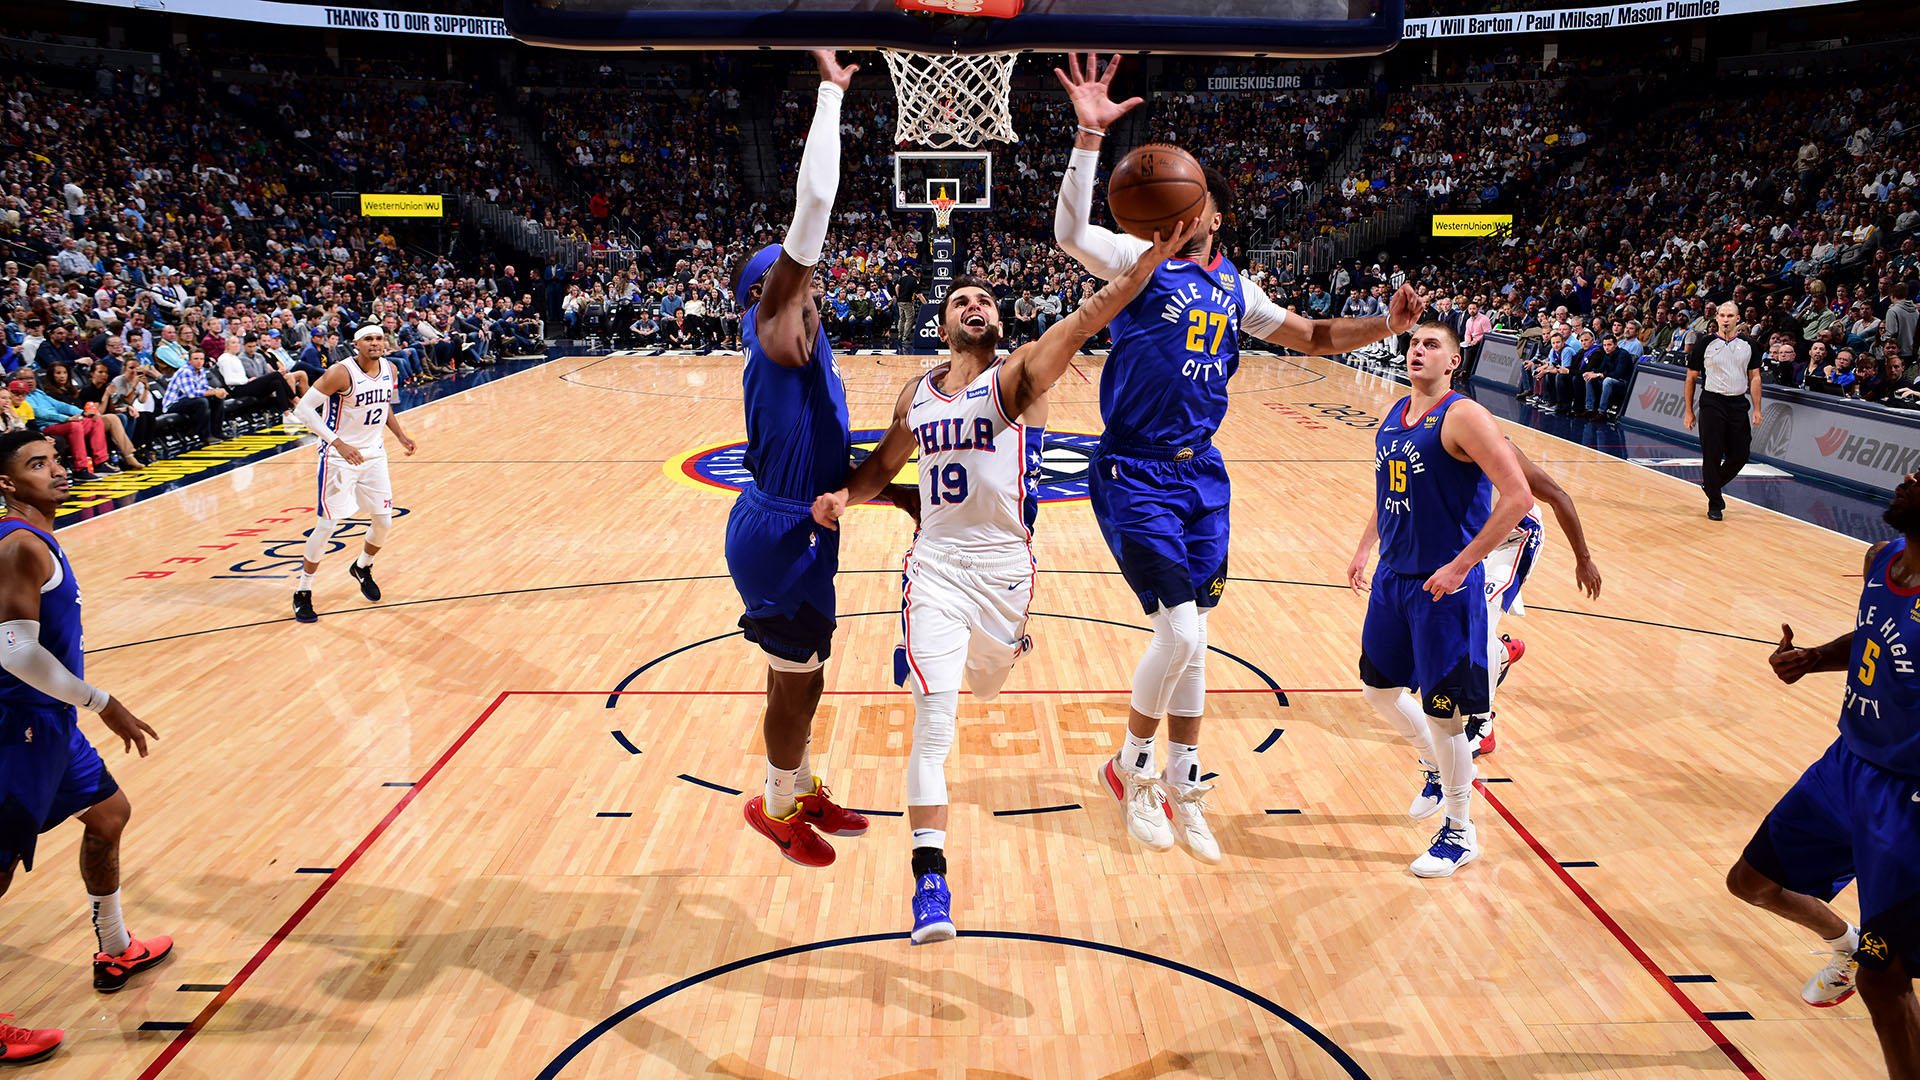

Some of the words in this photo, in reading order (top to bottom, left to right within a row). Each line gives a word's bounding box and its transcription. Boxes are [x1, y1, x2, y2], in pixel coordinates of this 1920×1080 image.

[325, 8, 379, 28] THANKS
[383, 12, 400, 30] TO
[404, 14, 430, 32] OUR
[1440, 18, 1464, 35] Will
[1468, 17, 1513, 34] Barton
[1526, 12, 1555, 31] Paul
[1618, 6, 1662, 25] Mason
[1666, 0, 1720, 20] Plumlee
[1207, 75, 1301, 90] EDDIESKIDS.ORG
[1161, 282, 1202, 324] MILE
[1211, 286, 1238, 331] HIGH
[1185, 309, 1229, 355] 27
[1181, 358, 1223, 382] CITY
[363, 408, 383, 426] 12
[1375, 439, 1399, 472] MILE
[1402, 440, 1425, 474] HIGH
[930, 463, 969, 505] 19
[1388, 459, 1407, 493] 15
[1385, 497, 1411, 515] CITY
[123, 506, 316, 581] CENTER
[1858, 638, 1880, 686] 5
[1880, 617, 1915, 673] HIGH
